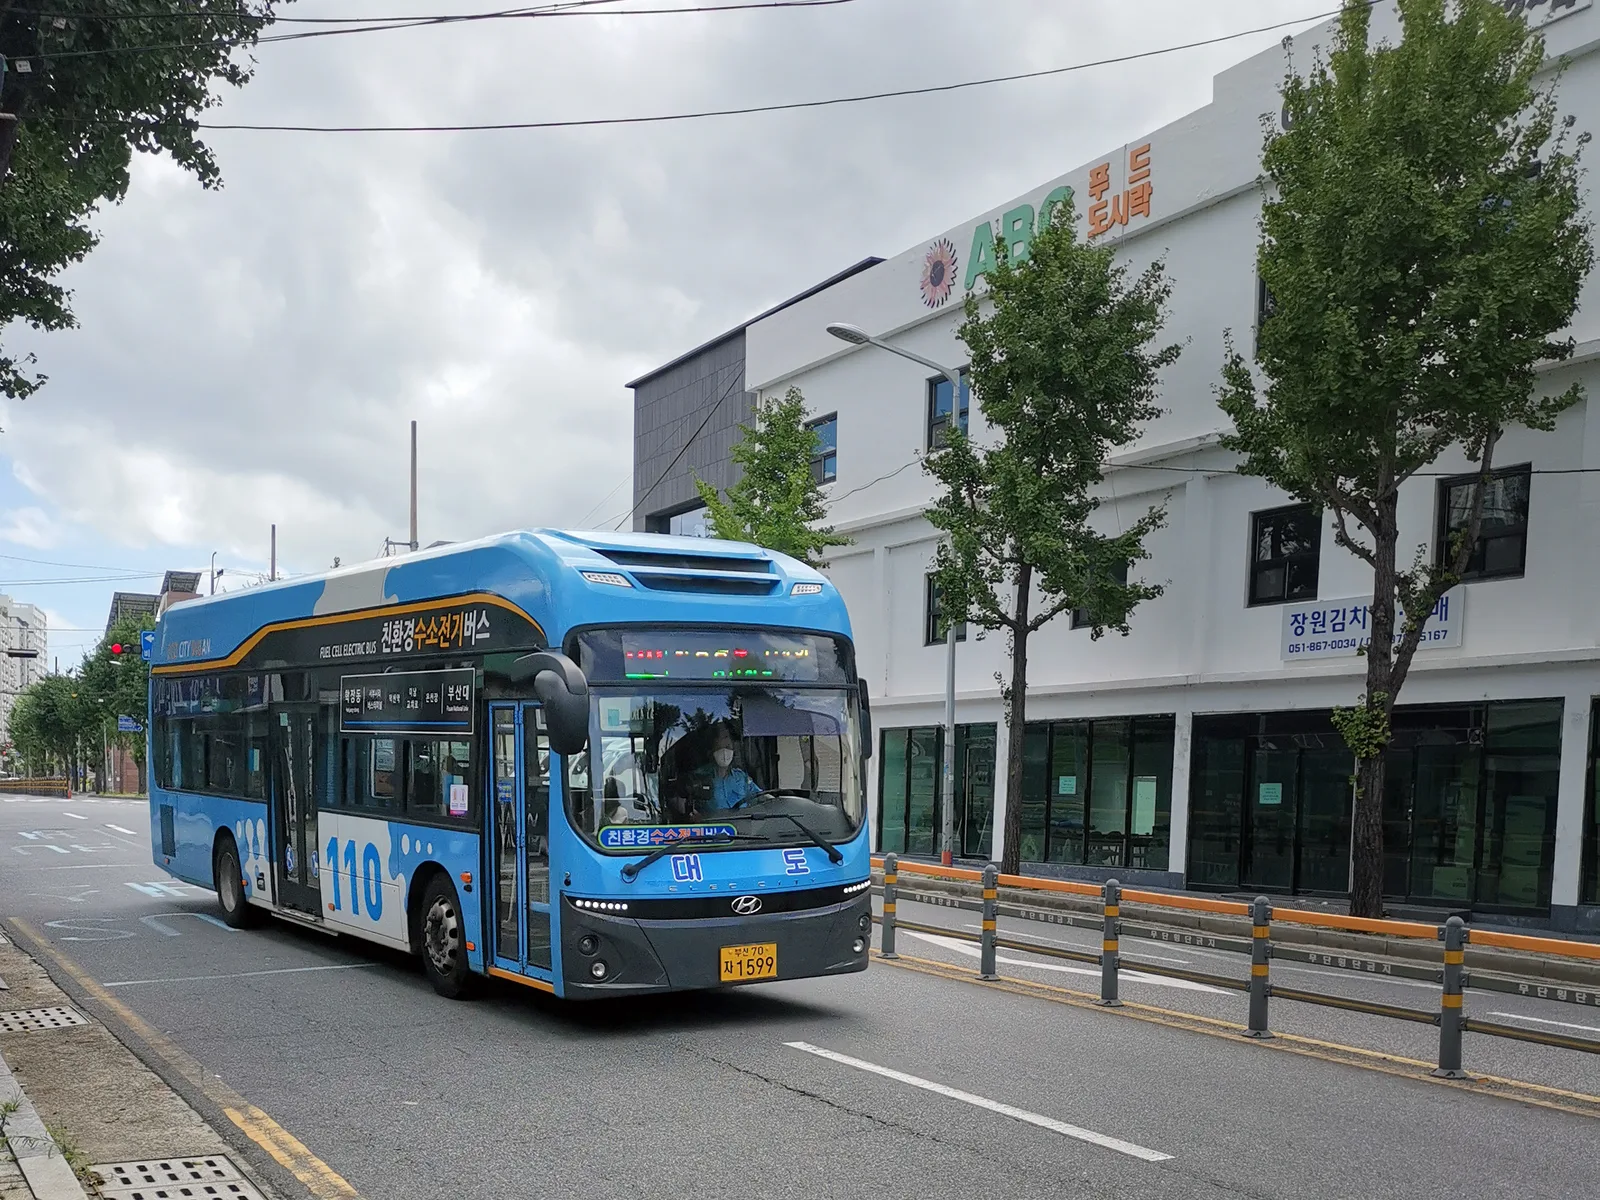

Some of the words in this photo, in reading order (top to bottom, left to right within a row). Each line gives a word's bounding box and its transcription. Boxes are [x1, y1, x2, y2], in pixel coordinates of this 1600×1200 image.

[1087, 181, 1153, 239] 도시락
[1290, 606, 1368, 637] 장원김치
[381, 610, 491, 653] 친환경수소전기버스
[343, 641, 366, 656] ELECTRIC
[366, 640, 377, 654] BUS
[1288, 637, 1357, 654] 051-867-0034
[344, 689, 362, 704] 학장동
[448, 684, 470, 702] 부산대
[671, 854, 704, 882] 대
[782, 848, 811, 876] 도
[326, 836, 383, 922] 110
[1020, 910, 1074, 925] 무단횡단금지
[1150, 930, 1216, 948] 무단횡단금지
[1309, 953, 1391, 974] 무단횡단금지
